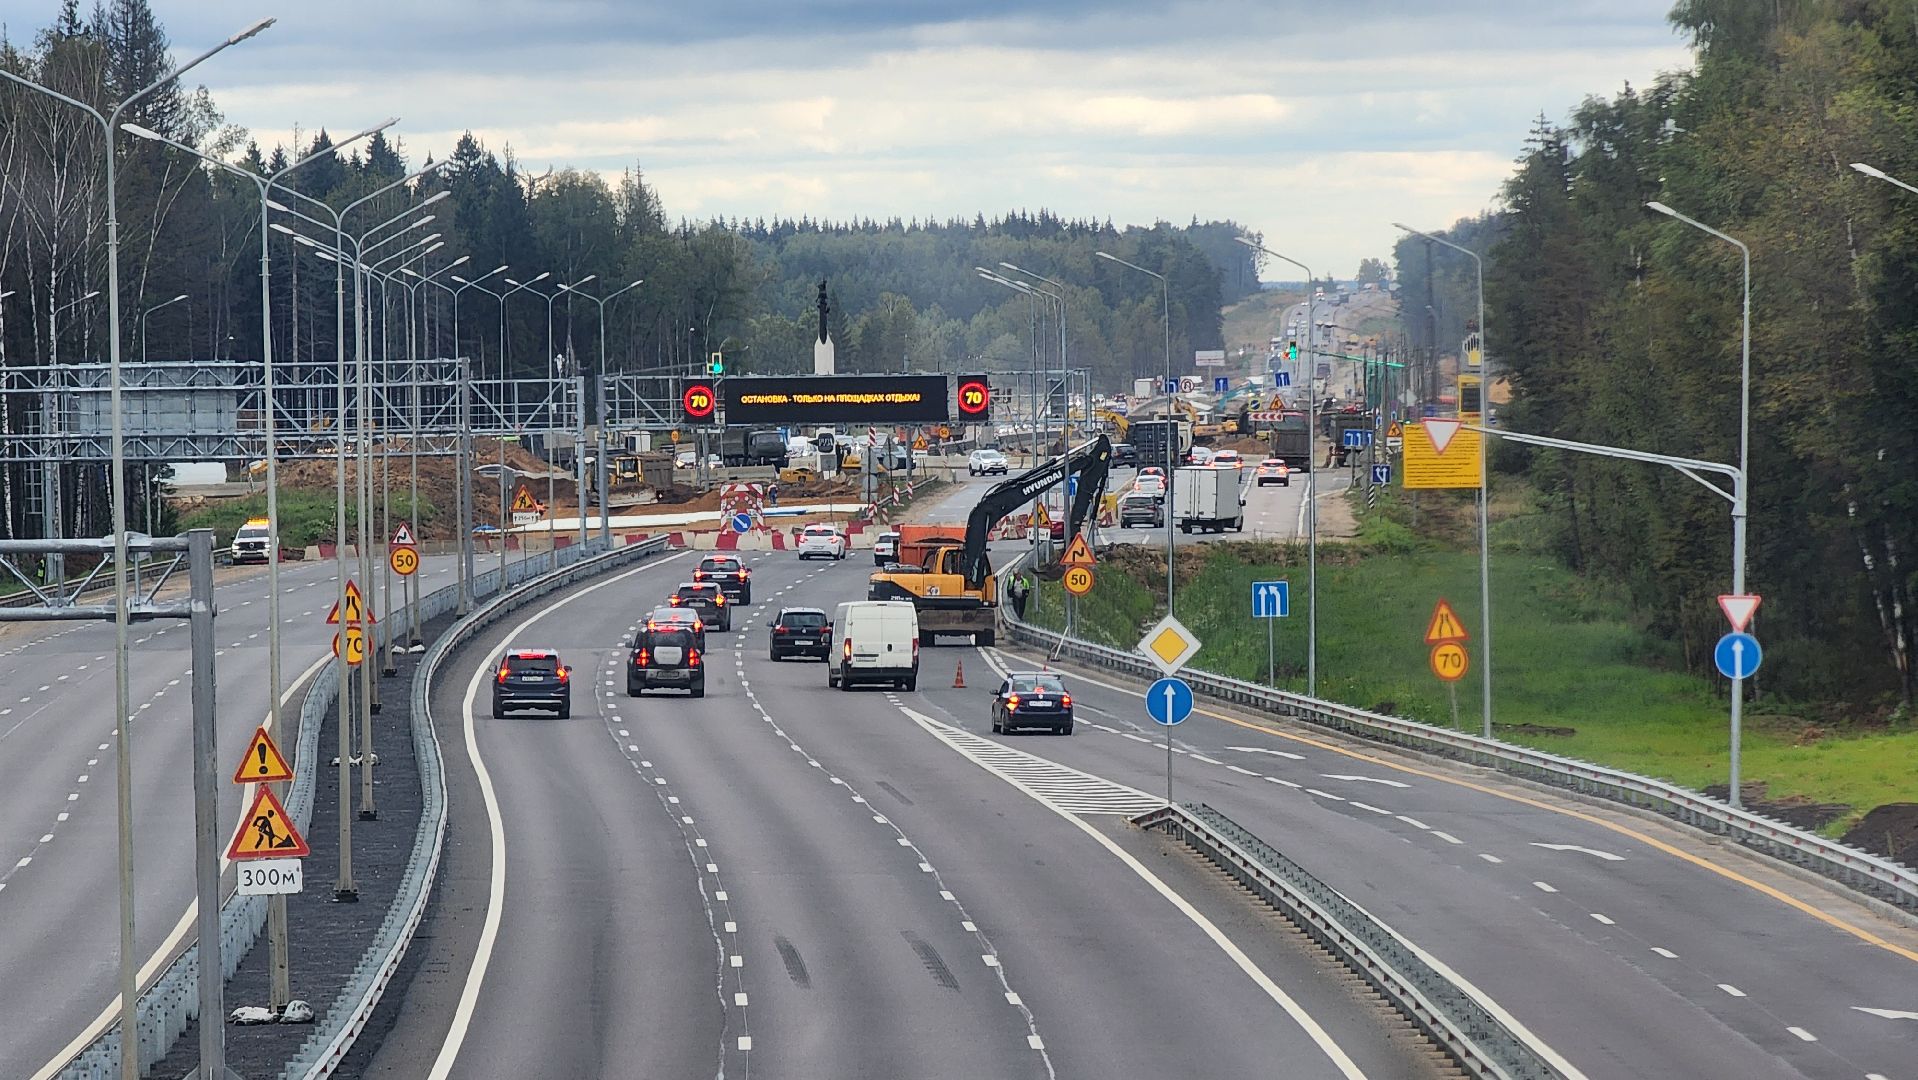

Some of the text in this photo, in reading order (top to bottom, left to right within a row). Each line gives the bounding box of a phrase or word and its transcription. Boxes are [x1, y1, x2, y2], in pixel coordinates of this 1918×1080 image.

[690, 395, 708, 408] 70
[741, 395, 788, 404] ОСТАНОВКА
[793, 394, 824, 403] ТОЛЬКО
[824, 394, 835, 402] НА
[836, 393, 885, 403] ПЛОЩАДКАХ
[885, 393, 920, 403] ОТДЫХА!
[965, 391, 982, 404] 70
[1022, 470, 1063, 496] HYUNDAI
[396, 554, 414, 568] 50
[1071, 574, 1087, 586] 50
[1438, 652, 1461, 669] 70
